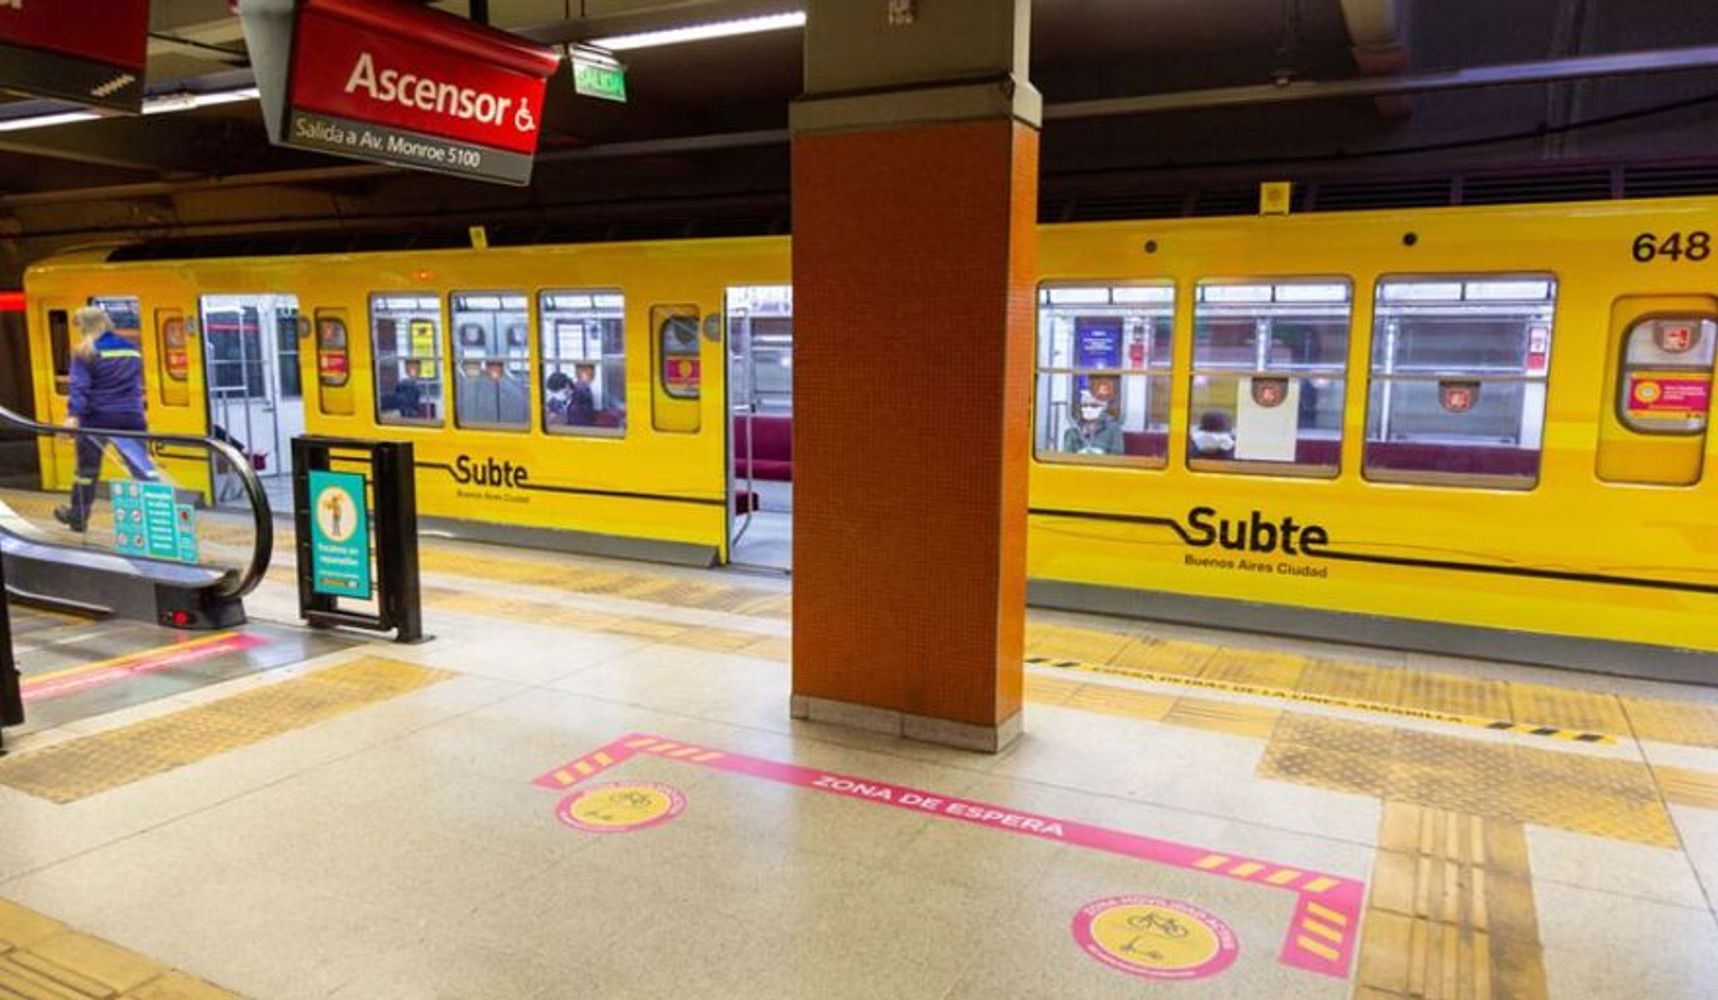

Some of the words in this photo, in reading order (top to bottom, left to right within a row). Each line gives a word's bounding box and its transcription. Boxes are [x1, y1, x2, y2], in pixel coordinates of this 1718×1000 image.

[345, 52, 512, 125] Ascensor
[295, 118, 344, 143] Salida
[346, 131, 357, 144] a
[360, 132, 384, 150] Av.
[388, 135, 446, 163] Monroe
[448, 148, 480, 168] 5100
[1632, 231, 1711, 263] 648
[456, 454, 528, 489] Subte
[1186, 506, 1329, 556] Subte
[1185, 554, 1234, 569] Buenos
[1238, 559, 1273, 573] Aires
[1277, 563, 1328, 579] Ciudad
[811, 775, 892, 801] ZONA
[898, 791, 943, 811] DE
[946, 802, 1064, 837] ESPERA
